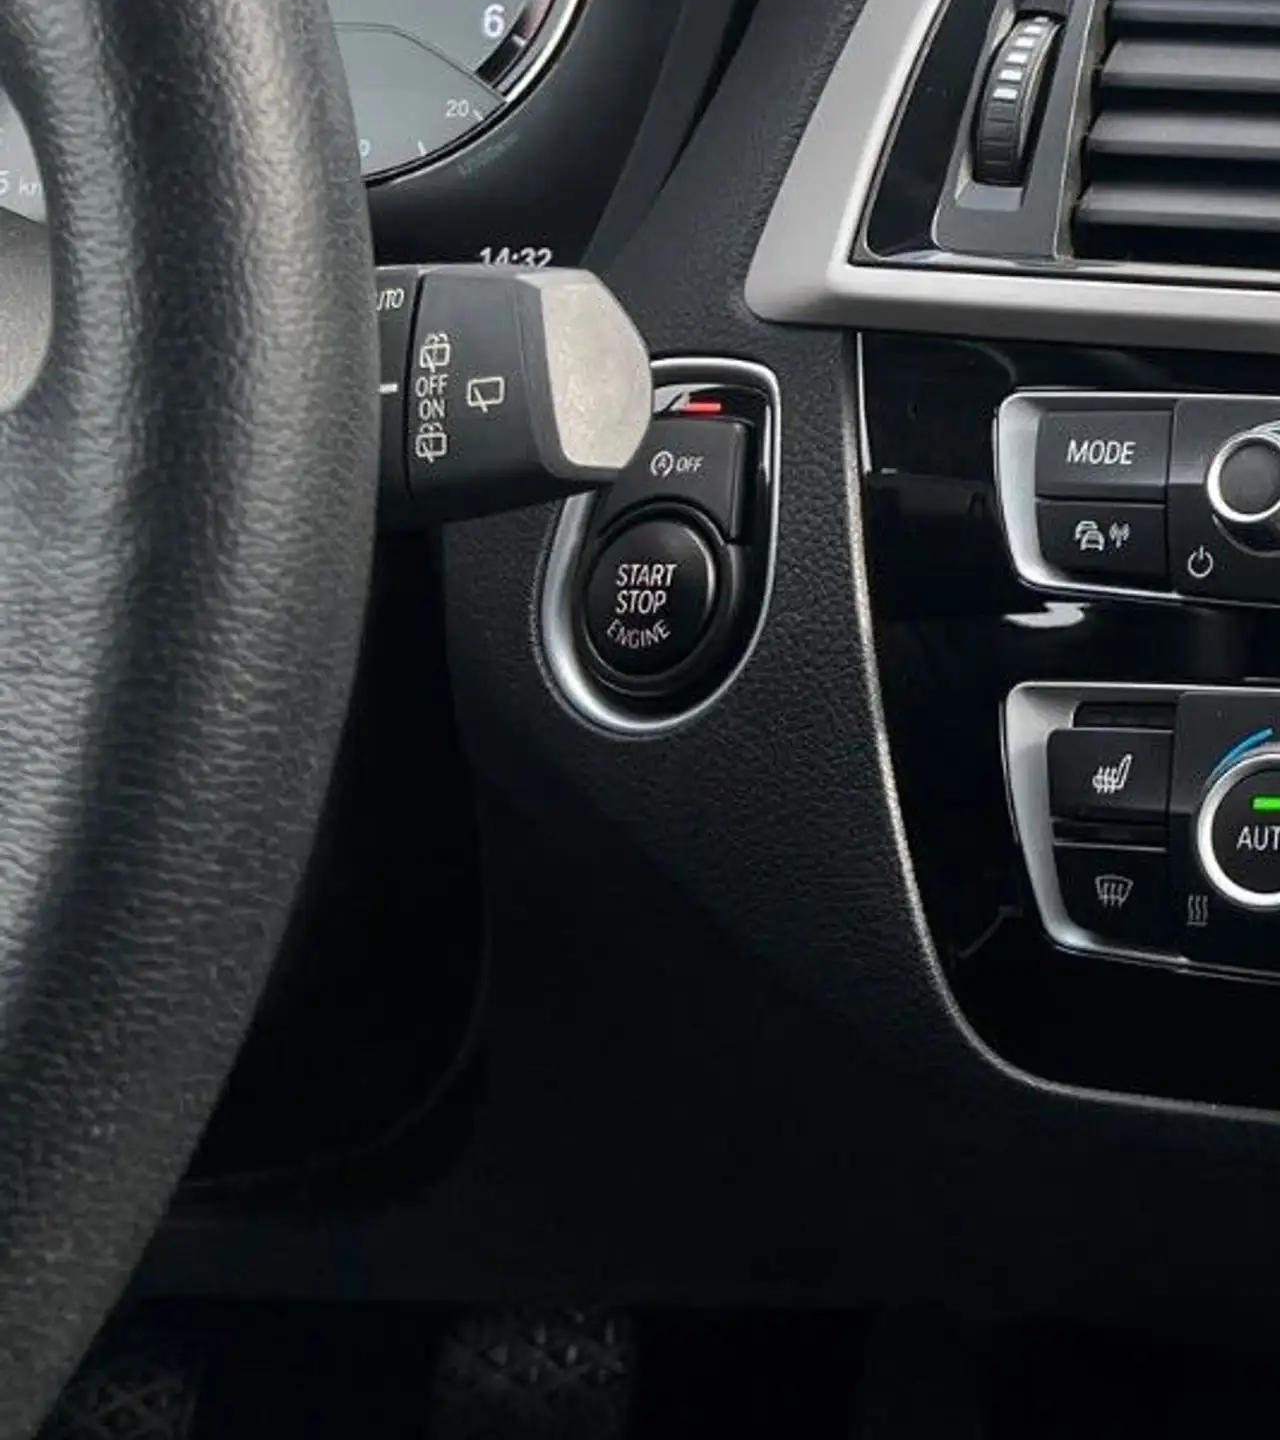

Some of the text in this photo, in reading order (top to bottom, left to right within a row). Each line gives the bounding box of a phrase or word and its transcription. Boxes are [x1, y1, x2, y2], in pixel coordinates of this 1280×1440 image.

[483, 2, 506, 38] 6
[445, 98, 470, 118] 20
[479, 246, 553, 270] 14:32
[415, 373, 449, 398] OFF
[419, 397, 446, 421] ON
[675, 455, 705, 474] OFF
[1066, 438, 1138, 466] MODE
[615, 563, 678, 588] START
[615, 589, 668, 616] STOP
[606, 618, 672, 650] ENGINE
